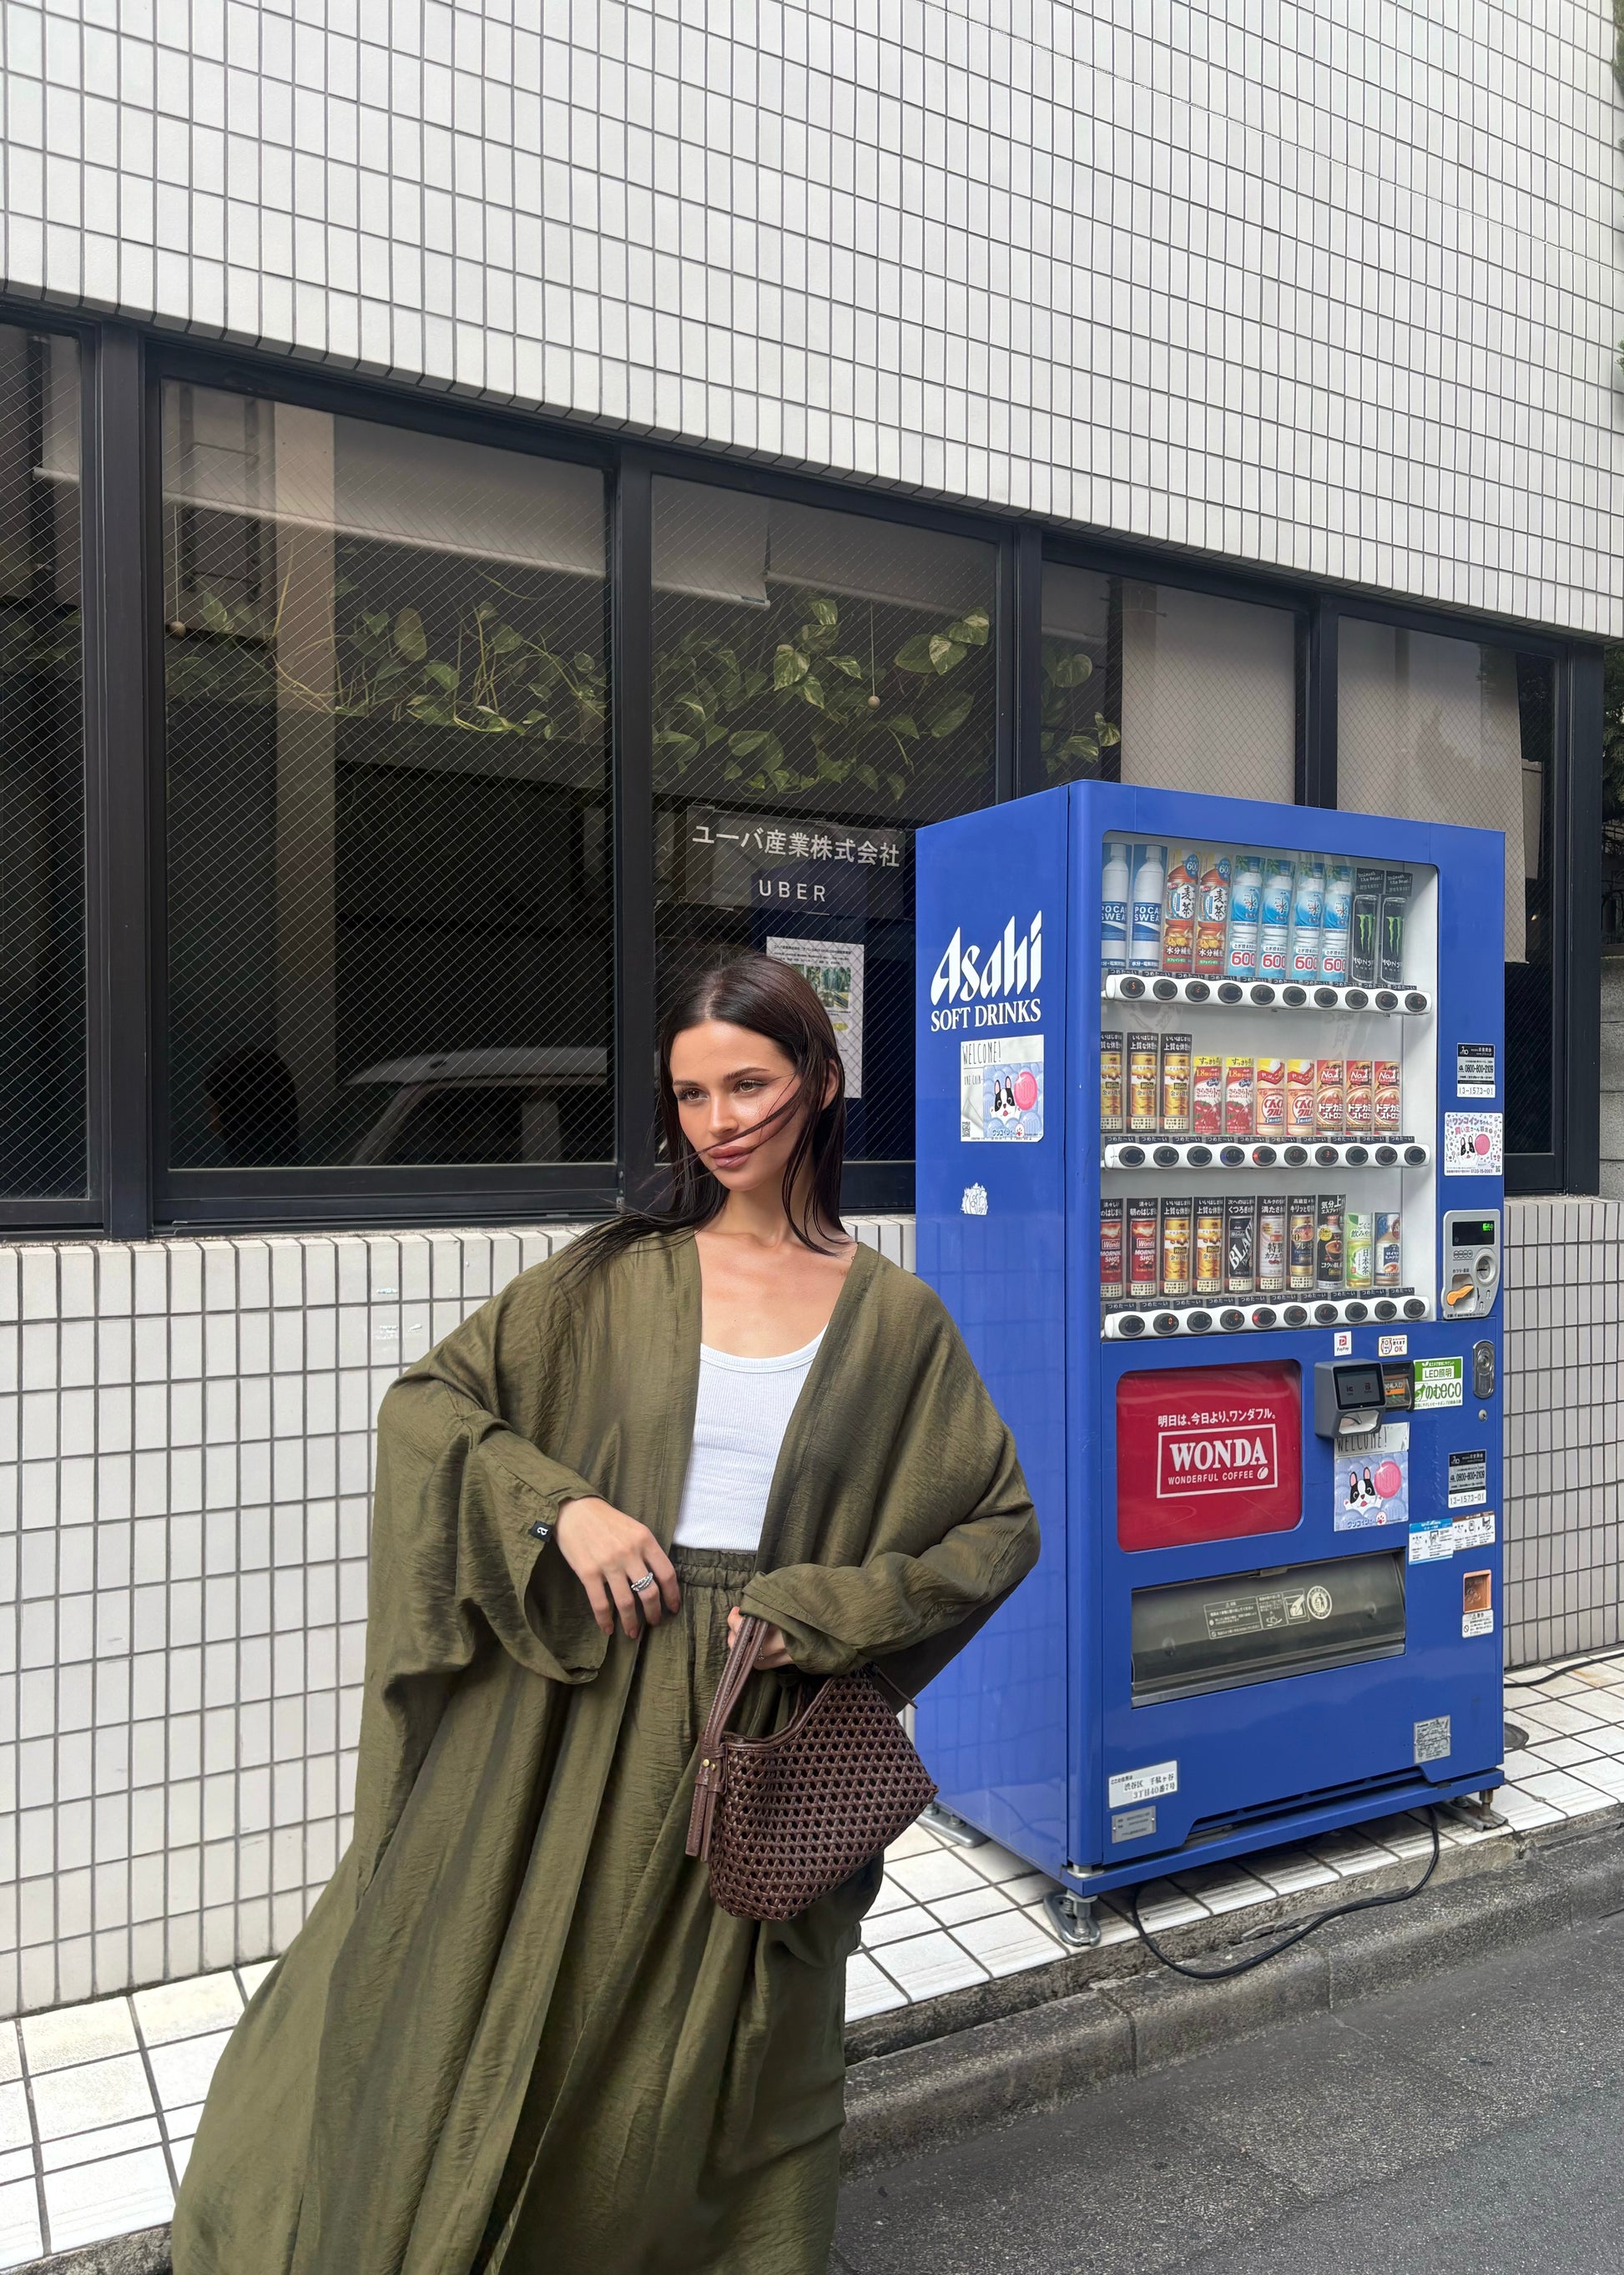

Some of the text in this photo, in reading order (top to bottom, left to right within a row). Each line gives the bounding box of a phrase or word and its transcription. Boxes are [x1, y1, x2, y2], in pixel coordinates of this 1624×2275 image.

[692, 825, 900, 868] ユーバ産業株式会社
[759, 879, 826, 902] UBER
[930, 910, 1042, 1006] Asahi
[931, 998, 1041, 1032] SOFT DRINKS
[962, 1041, 1001, 1065] WELCOME!
[1459, 1087, 1493, 1096] 13-1573-01
[1425, 1367, 1452, 1379] LED照明
[1425, 1382, 1462, 1400] のむeco
[1157, 1408, 1276, 1428] 明日は、今日より、ワンダフル。
[1168, 1436, 1268, 1472] WONDA
[1168, 1470, 1253, 1486] WONDERFUL COFFEE
[1450, 1492, 1485, 1506] 13-1573-01
[1123, 1780, 1144, 1791] 渋谷区
